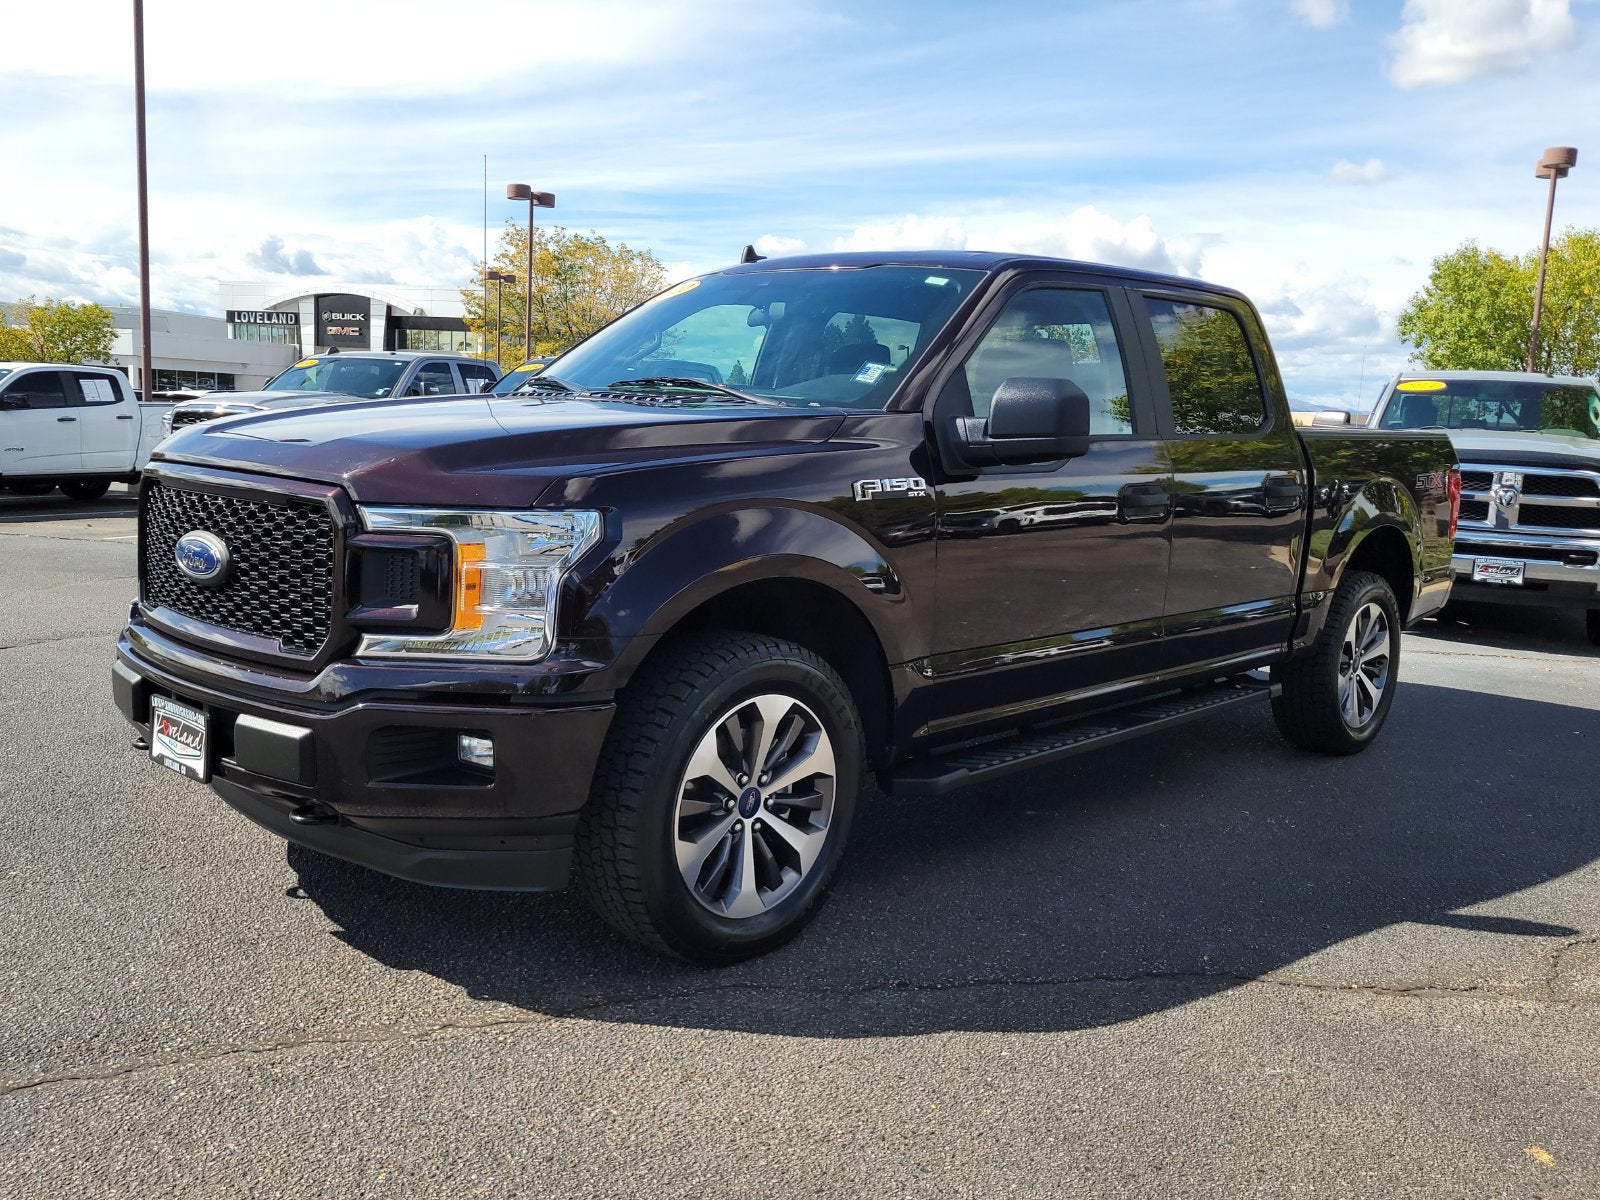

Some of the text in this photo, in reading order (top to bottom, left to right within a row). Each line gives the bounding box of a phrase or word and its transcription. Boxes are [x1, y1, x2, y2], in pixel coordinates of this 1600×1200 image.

[235, 312, 295, 325] LOVELAND
[331, 312, 365, 321] BUICK
[327, 326, 360, 336] GMC
[1415, 472, 1443, 489] STX
